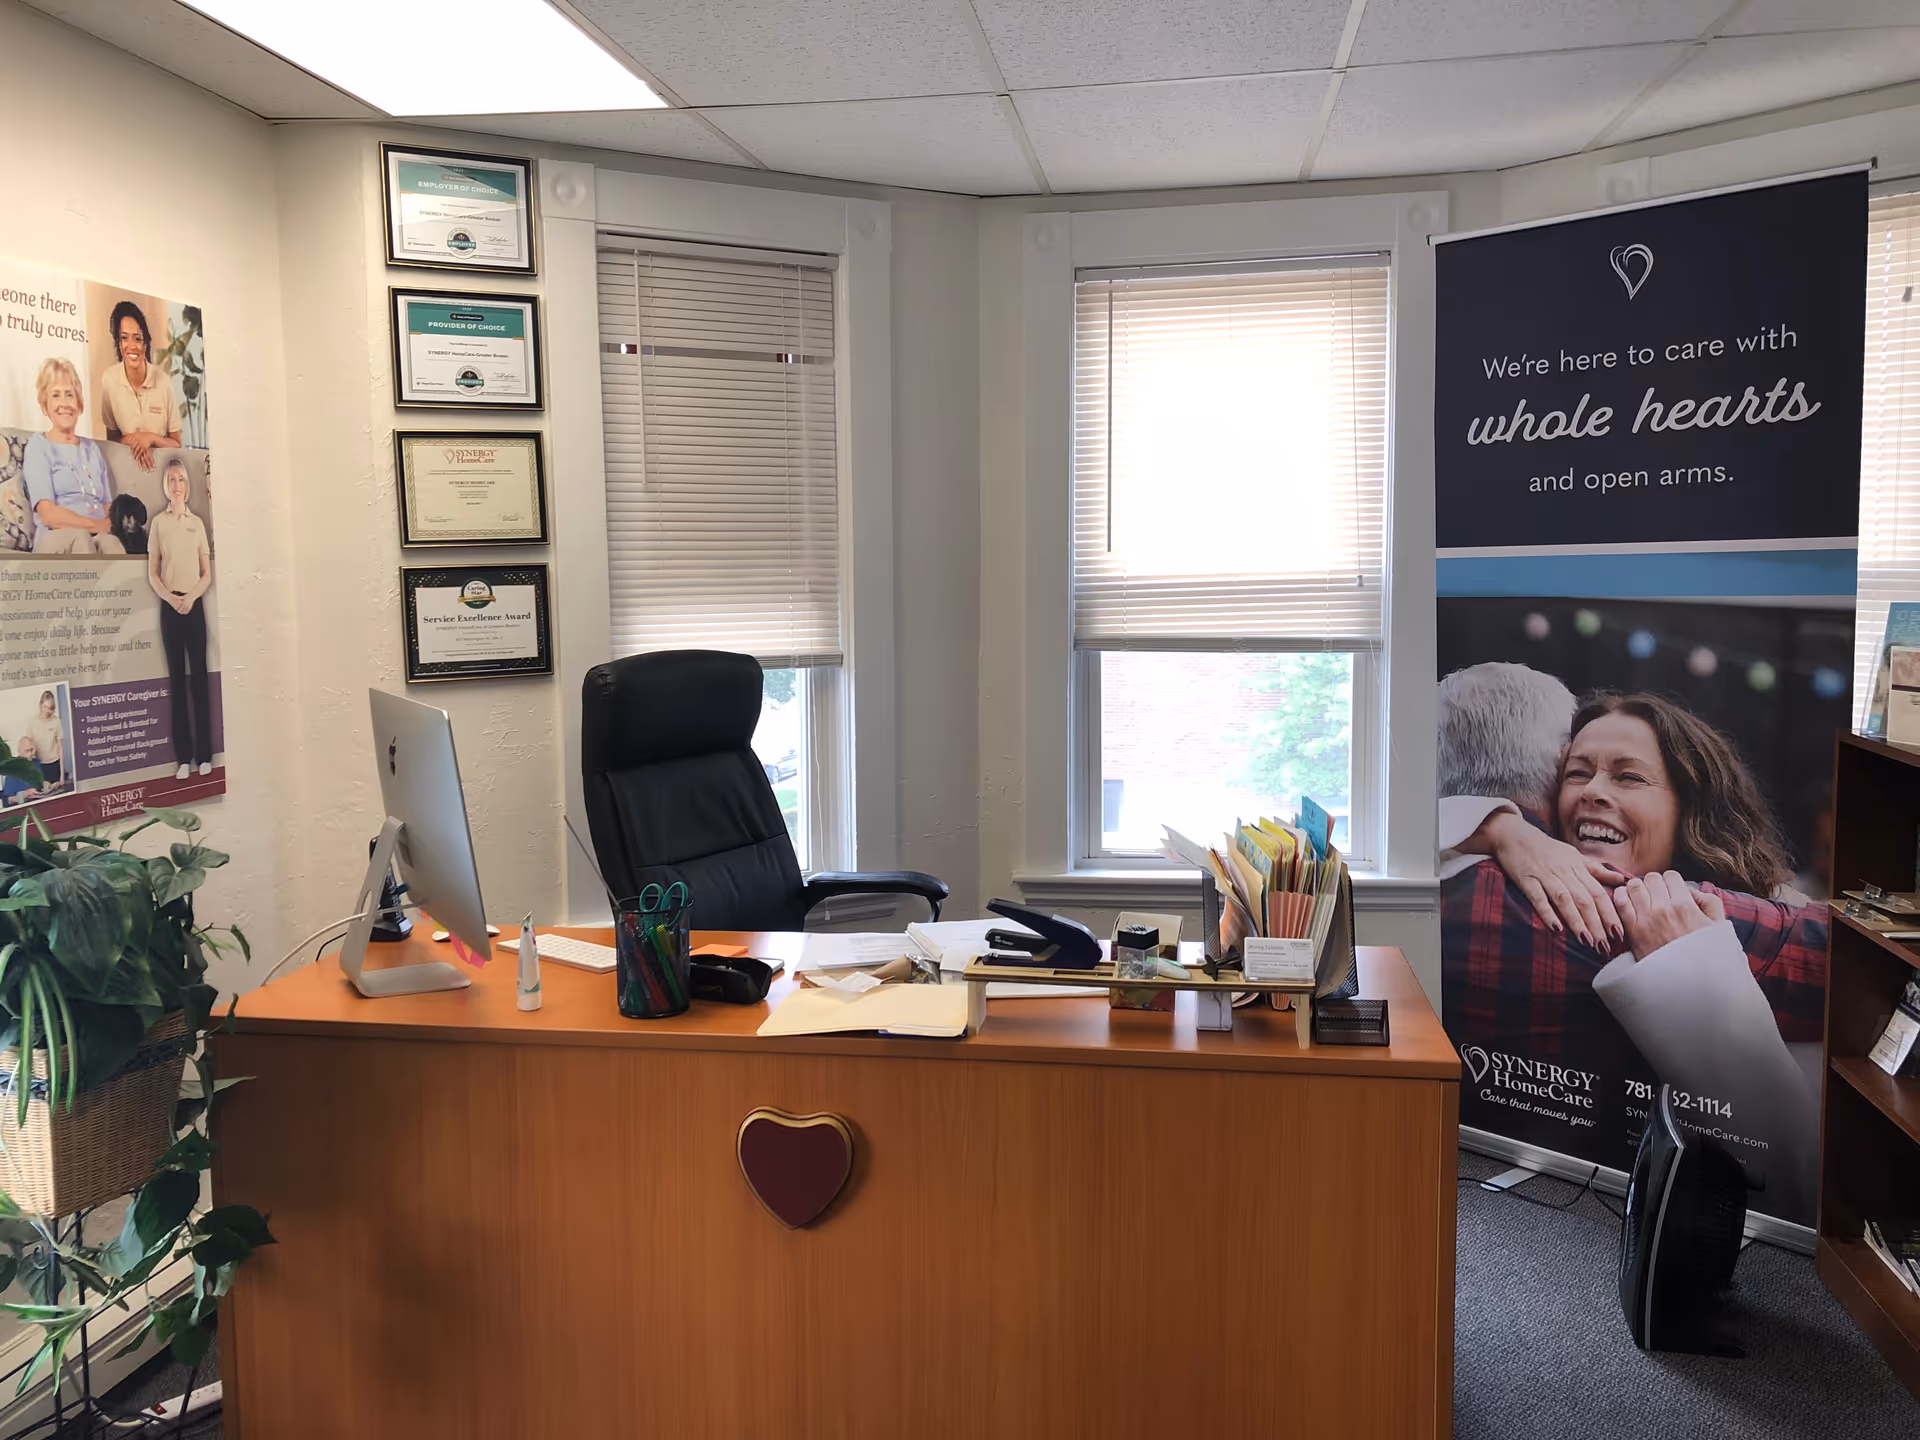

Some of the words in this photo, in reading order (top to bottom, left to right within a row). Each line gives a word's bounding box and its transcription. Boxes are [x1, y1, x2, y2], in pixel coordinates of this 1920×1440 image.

[418, 181, 459, 191] EMPLOYER
[471, 186, 499, 194] CHOICE
[0, 288, 36, 307] eone
[40, 292, 76, 316] there
[7, 313, 43, 338] truly
[48, 324, 89, 343] cares.
[1482, 353, 1550, 380] We're
[1560, 349, 1617, 373] here
[1627, 345, 1655, 365] to
[1665, 339, 1725, 362] care
[1736, 324, 1798, 353] with
[1467, 393, 1613, 445] whole
[1631, 377, 1822, 434] hearts
[1529, 467, 1574, 492] and
[1584, 469, 1649, 494] open
[1660, 465, 1734, 486] arms.
[25, 589, 72, 600] HomeCare
[74, 588, 118, 600] Caregivers
[119, 589, 132, 598] are
[47, 607, 63, 618] and
[65, 606, 83, 620] help
[85, 609, 100, 620] you
[102, 608, 111, 616] or
[113, 607, 131, 620] your
[423, 615, 455, 623] Service
[457, 613, 502, 622] Excellence
[505, 612, 531, 620] Award
[24, 628, 47, 641] enjoy
[91, 625, 120, 636] Because
[23, 647, 49, 659] needs
[59, 644, 78, 656] little
[80, 643, 97, 656] help
[118, 641, 133, 651] and
[78, 662, 97, 673] here
[73, 699, 90, 708] Your
[92, 693, 125, 706] SYNERGY
[127, 689, 159, 701] Caregiver
[101, 787, 145, 806] SYNERGY
[101, 800, 144, 817] HomeCare
[1493, 1068, 1593, 1108] HomeCare
[1480, 1088, 1508, 1105] Care
[1509, 1097, 1532, 1111] that
[1533, 1106, 1569, 1121] moves
